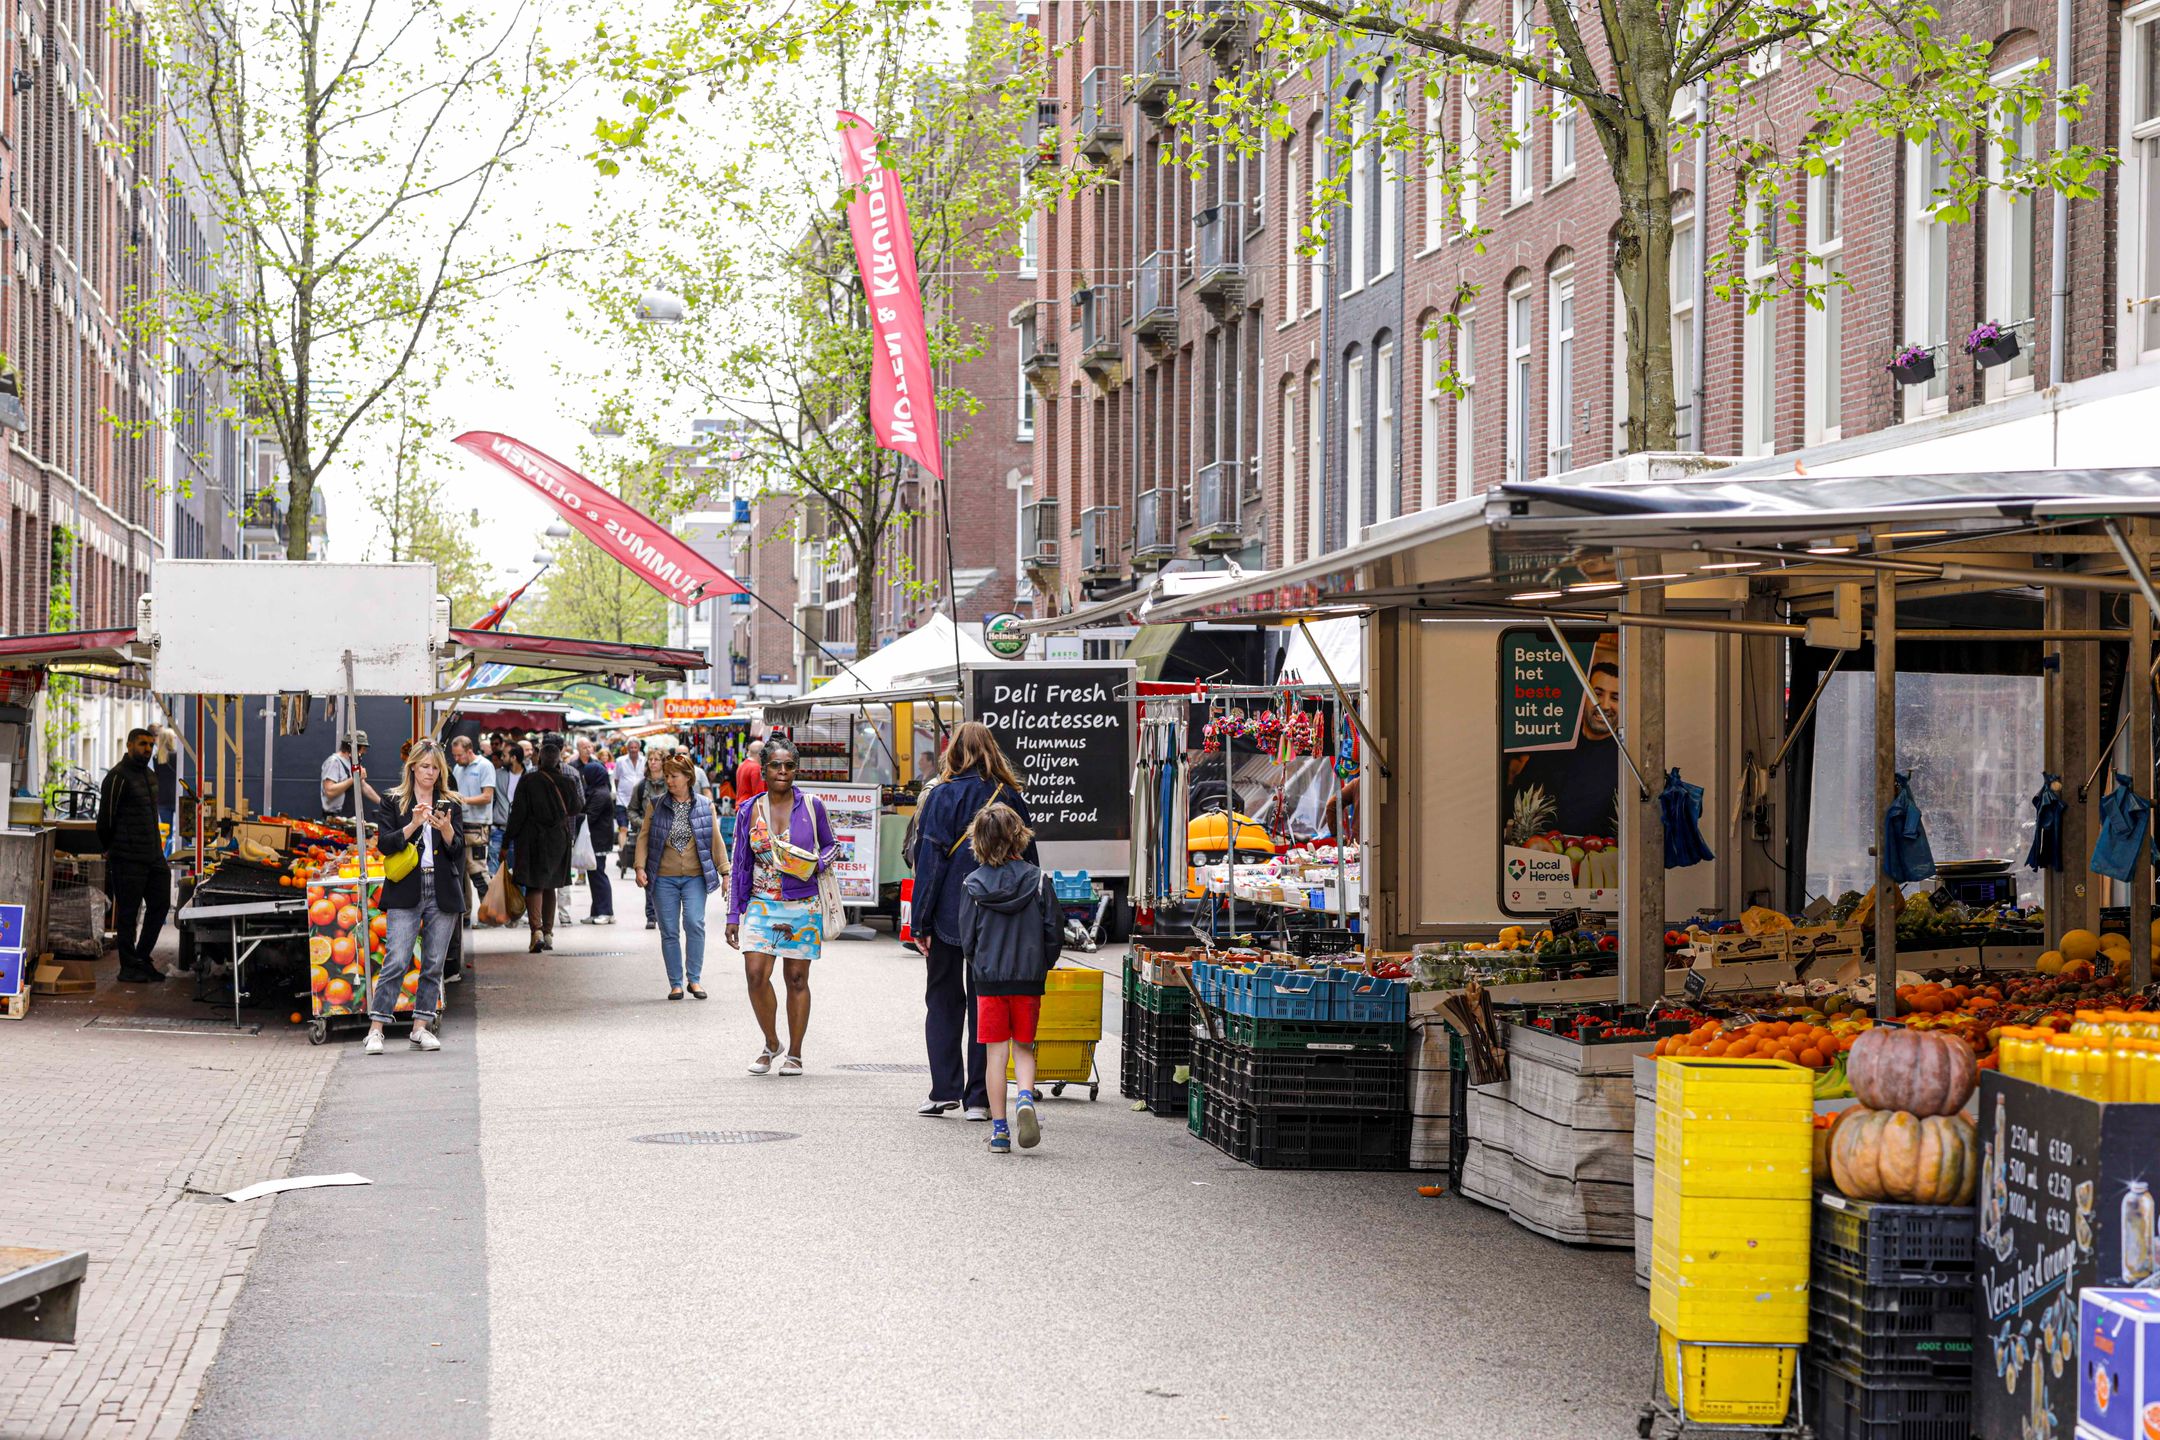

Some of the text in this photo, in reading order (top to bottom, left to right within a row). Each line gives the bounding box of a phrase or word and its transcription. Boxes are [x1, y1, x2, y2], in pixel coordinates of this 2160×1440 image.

[1515, 647, 1567, 662] Bestel
[1515, 666, 1543, 680] het
[994, 683, 1106, 704] Deli Fresh
[1515, 684, 1562, 699] beste
[667, 703, 733, 716] Orange Juice
[1515, 702, 1564, 717] uit de
[983, 710, 1119, 729] Delicatessen
[1515, 720, 1562, 735] buurt
[1016, 736, 1086, 750] Hummus
[1024, 754, 1079, 771] Olijven
[1028, 773, 1075, 786] Noten
[1020, 790, 1084, 805] Kruiden
[1060, 808, 1098, 823] Food
[1529, 858, 1560, 870] Local
[1529, 871, 1570, 882] Heroes
[2011, 1124, 2028, 1152] 250
[2028, 1130, 2039, 1156] ml
[2009, 1158, 2026, 1185] 500
[2027, 1166, 2038, 1190] ml
[2009, 1191, 2027, 1220] 1000
[2027, 1199, 2037, 1224] ml
[1982, 1266, 2016, 1319] Verse
[2018, 1259, 2035, 1318] jus
